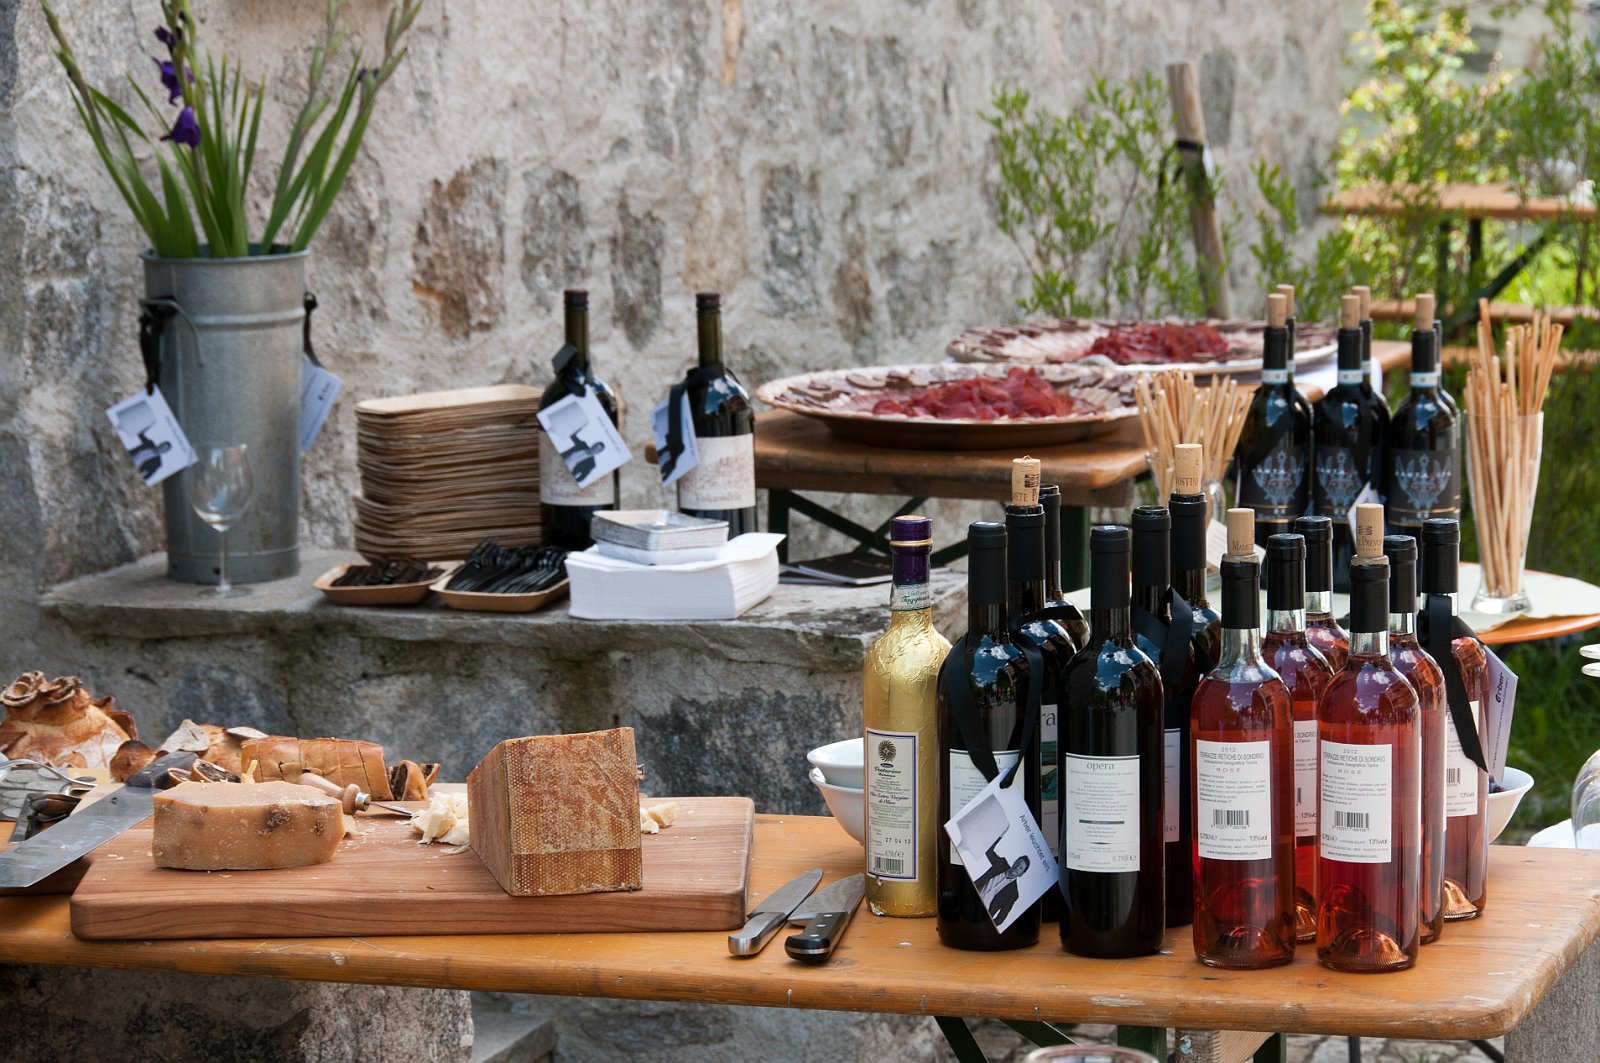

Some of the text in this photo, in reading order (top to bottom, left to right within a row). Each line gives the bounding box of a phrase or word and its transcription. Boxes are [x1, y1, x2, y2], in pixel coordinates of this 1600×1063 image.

[1086, 762, 1115, 772] opera
[1019, 814, 1050, 873] Arber leuchtet ein.
